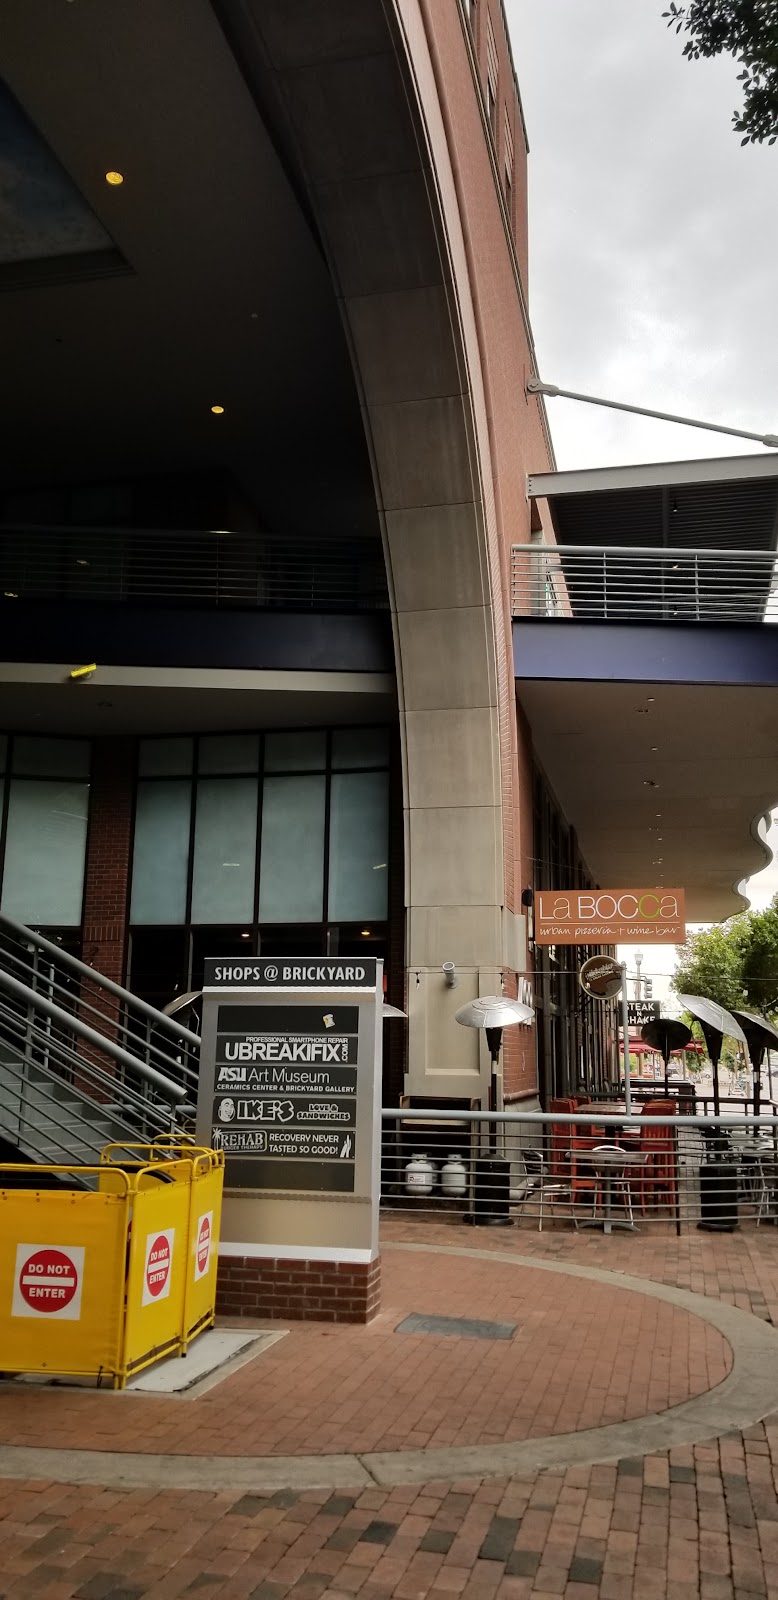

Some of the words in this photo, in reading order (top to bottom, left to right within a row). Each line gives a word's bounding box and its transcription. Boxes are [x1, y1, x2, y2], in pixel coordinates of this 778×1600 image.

[539, 926, 571, 936] urban
[574, 925, 617, 939] pizzeria
[626, 926, 655, 936] wine
[655, 925, 680, 936] bar
[214, 966, 261, 981] SHOPS
[264, 965, 279, 982] @
[282, 966, 366, 981] BRICKYARD
[627, 1016, 655, 1024] HAKE
[225, 1042, 341, 1062] UBREAKIFIX
[218, 1067, 247, 1082] ASU
[248, 1067, 269, 1083] Art
[272, 1068, 330, 1084] Museum
[216, 1083, 251, 1091] CERAMICS
[325, 1085, 355, 1093] GALLERY
[308, 1103, 330, 1112] LOVE
[330, 1103, 338, 1112] &
[296, 1111, 351, 1121] SANDWICHES
[221, 1133, 264, 1146] REHAB
[269, 1132, 311, 1143] RECOVERY
[312, 1134, 340, 1143] NEVER
[268, 1143, 298, 1153] TASTED
[299, 1144, 310, 1154] SO
[310, 1145, 339, 1155] GOOD!
[150, 1250, 158, 1262] DO
[157, 1247, 169, 1259] NOT
[28, 1263, 44, 1274] DO
[46, 1264, 70, 1275] NOT
[149, 1271, 166, 1285] ENTER
[28, 1287, 66, 1299] ENTER
